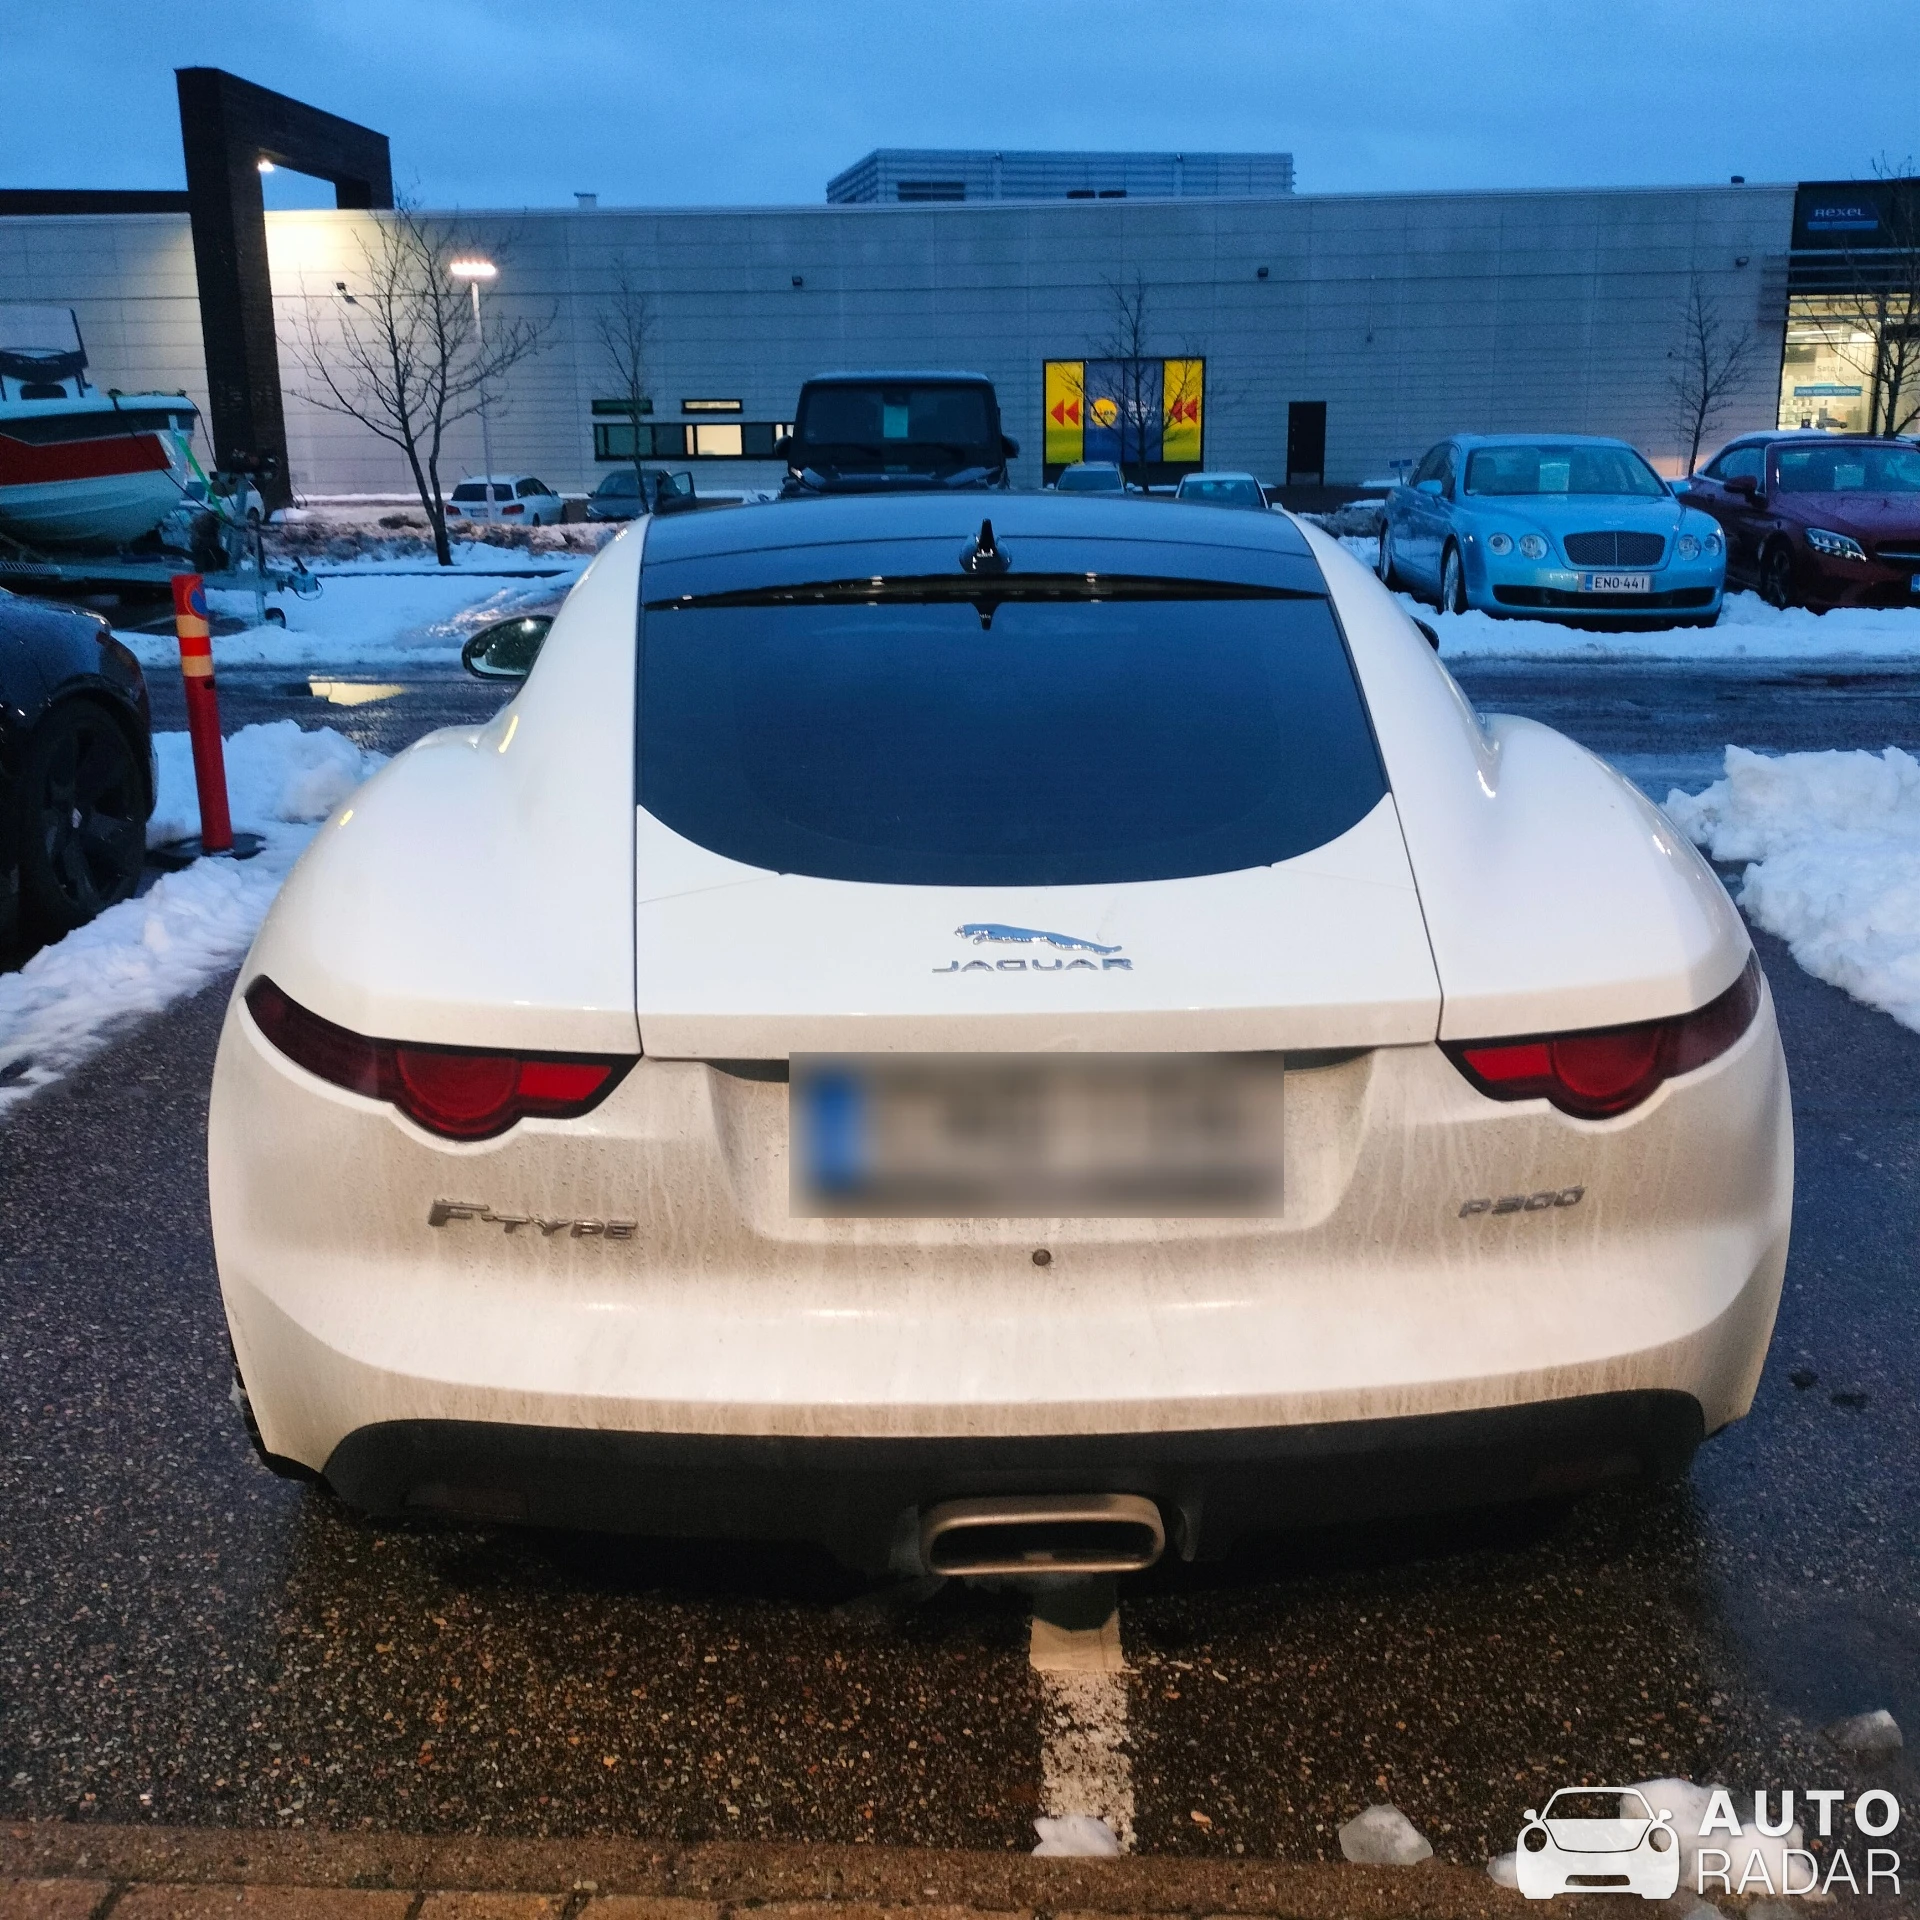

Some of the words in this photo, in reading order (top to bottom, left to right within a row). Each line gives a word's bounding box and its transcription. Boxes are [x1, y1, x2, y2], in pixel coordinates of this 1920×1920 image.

[1817, 365, 1844, 373] Satoa
[932, 958, 1134, 973] JAGUAR
[1458, 1185, 1586, 1218] P300
[428, 1199, 638, 1239] F-TYPE
